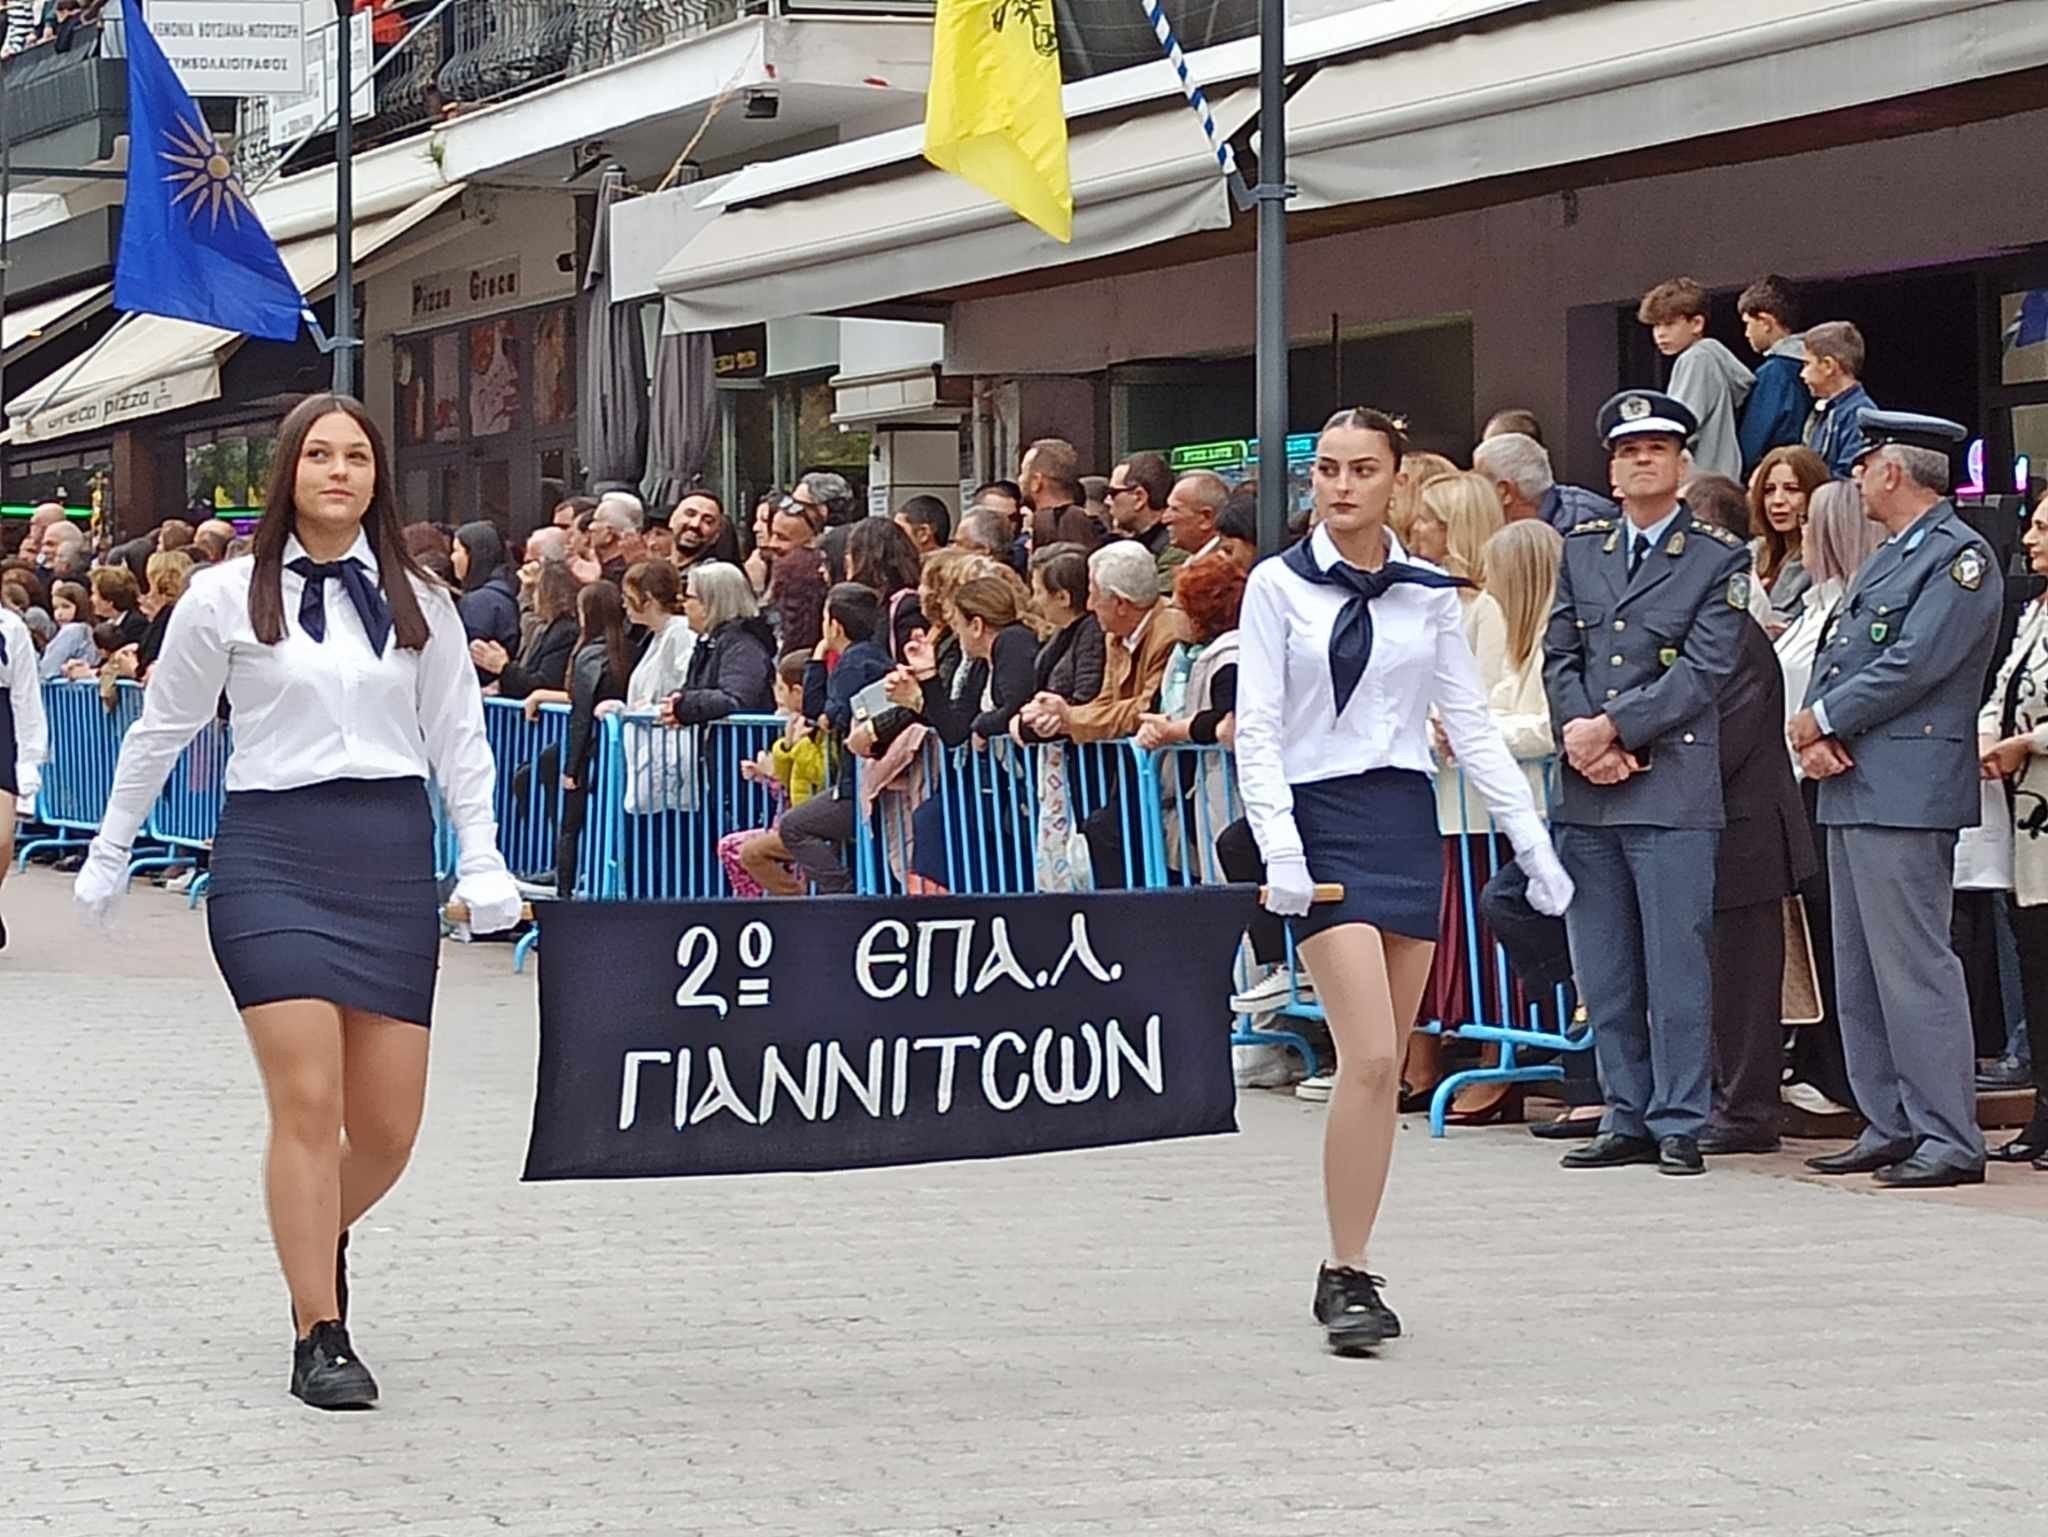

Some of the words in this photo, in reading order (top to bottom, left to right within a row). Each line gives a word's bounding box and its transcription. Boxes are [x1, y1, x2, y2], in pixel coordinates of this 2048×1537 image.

[172, 57, 288, 71] ΥΜΒΟΛΑΙΟΓΡΑΦΟΣ
[412, 284, 450, 316] Pizza
[469, 270, 515, 301] Greca
[103, 389, 150, 421] pizza
